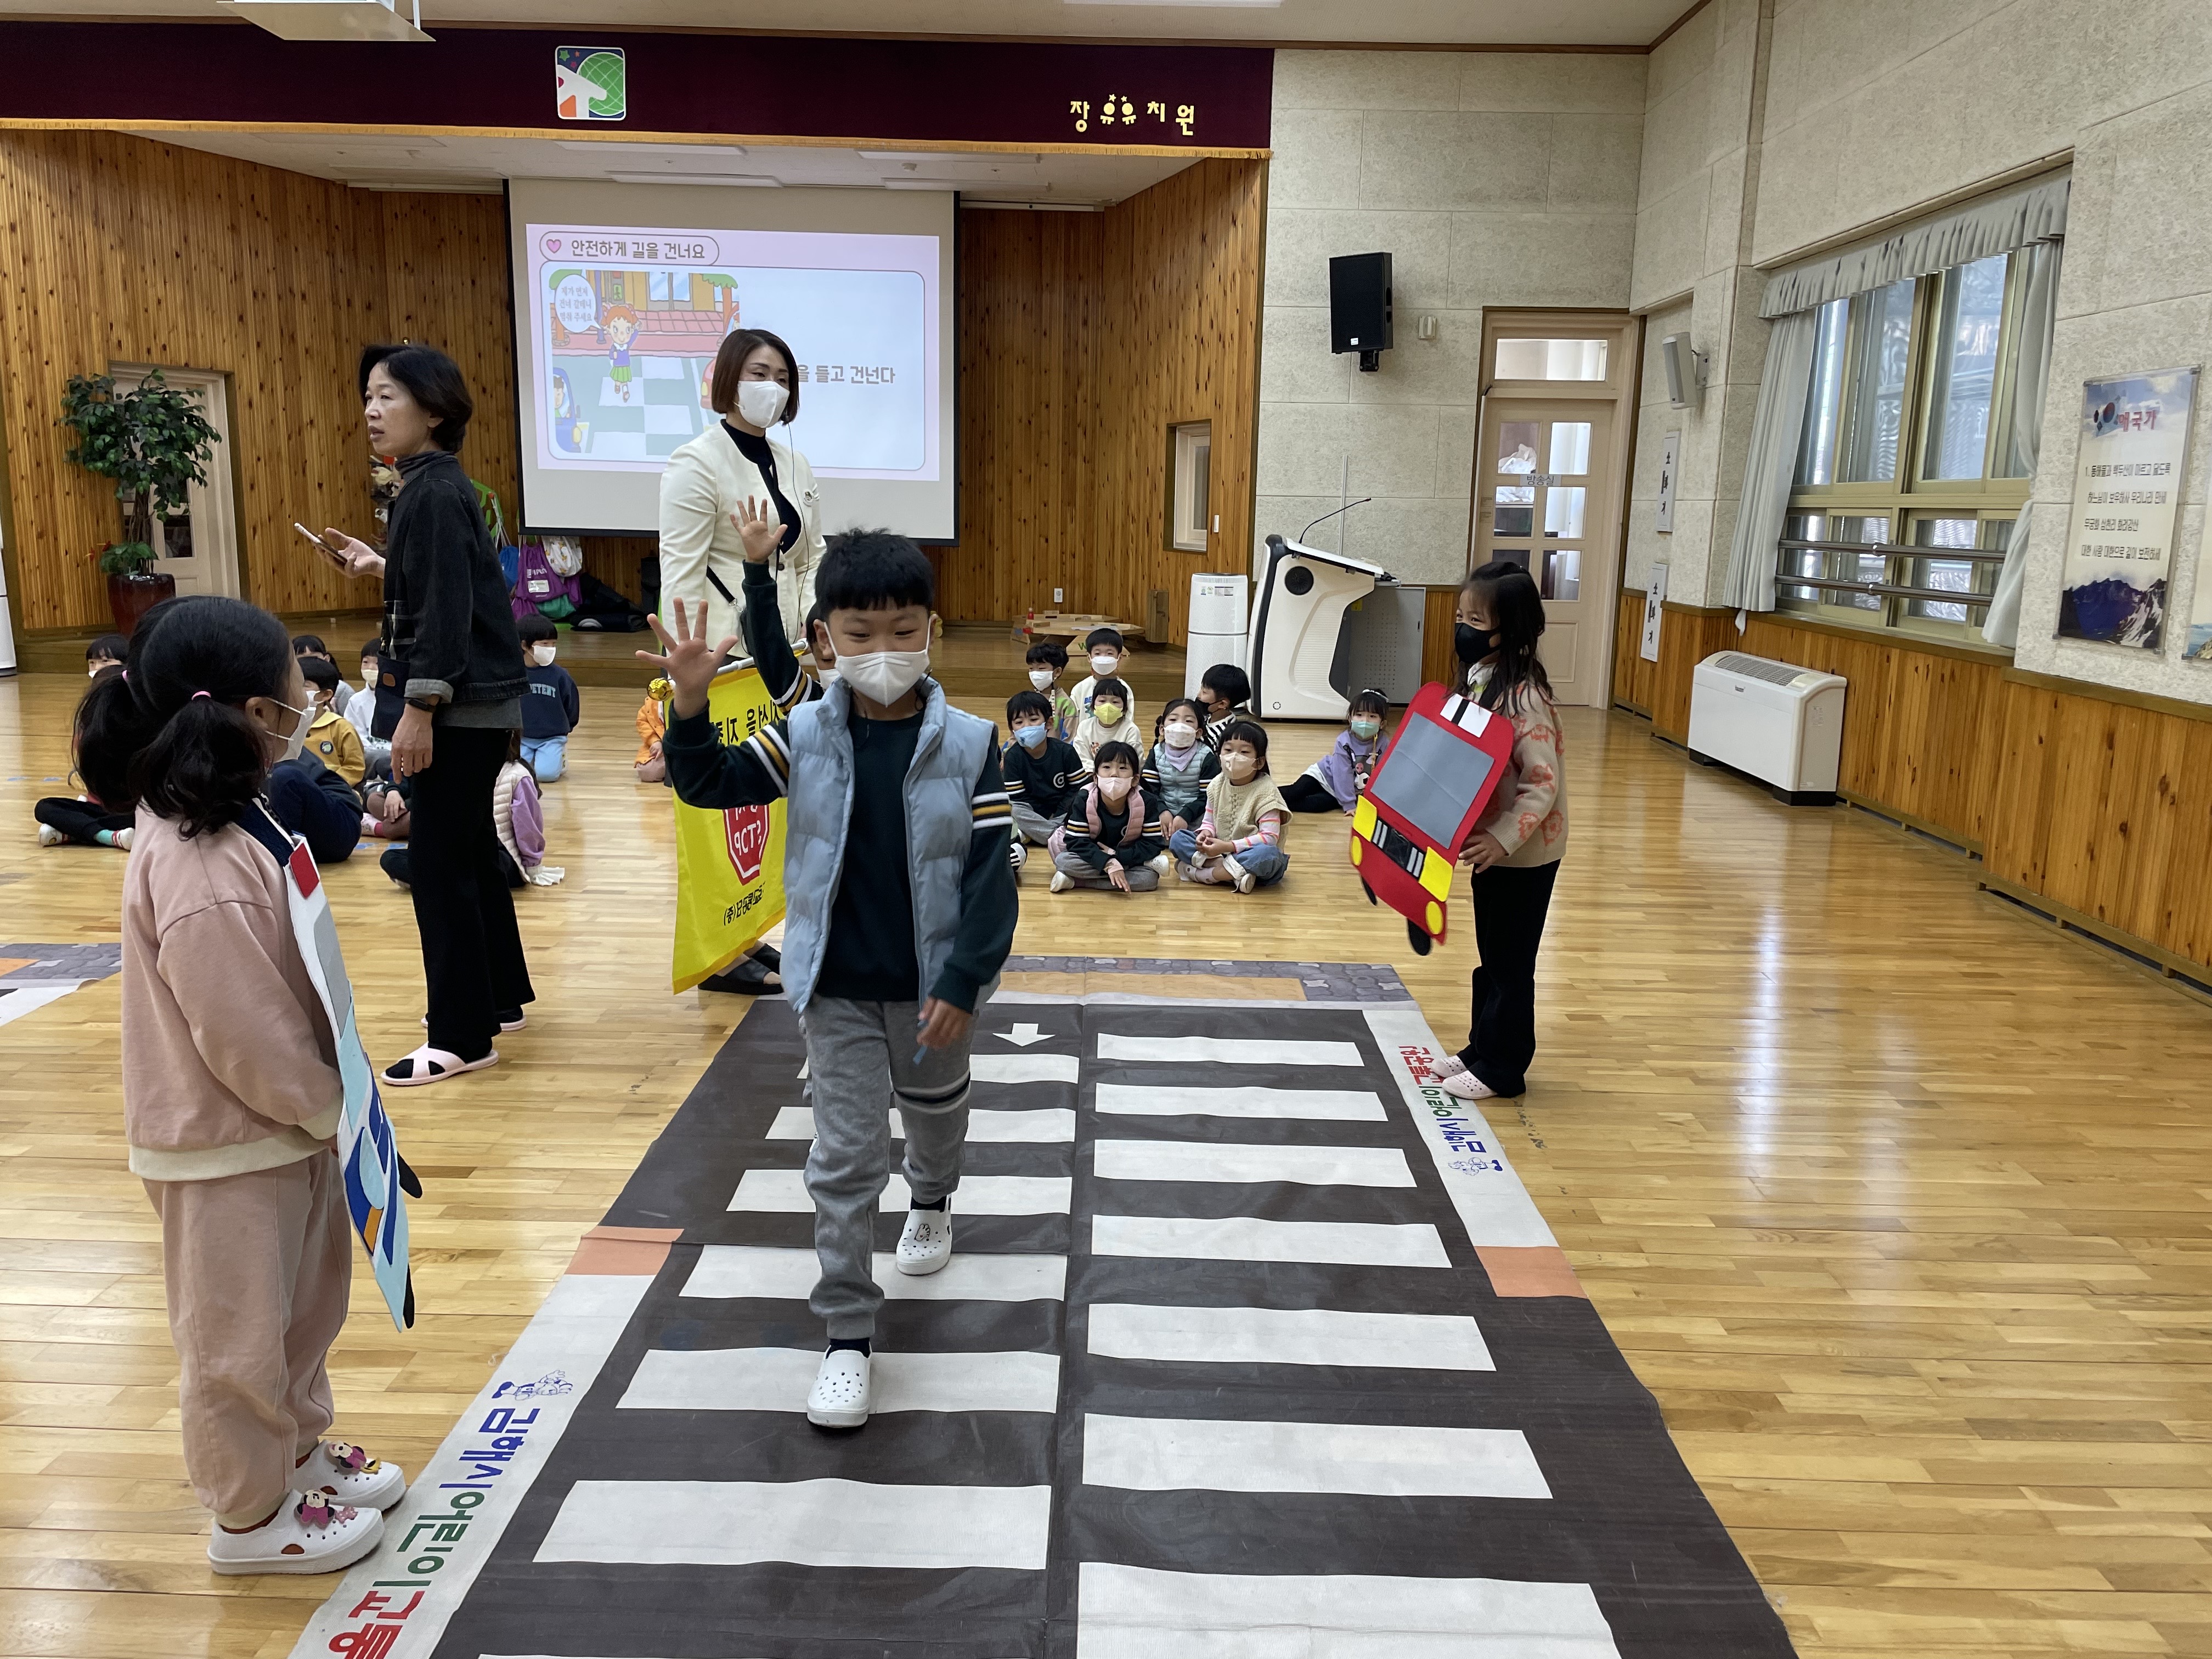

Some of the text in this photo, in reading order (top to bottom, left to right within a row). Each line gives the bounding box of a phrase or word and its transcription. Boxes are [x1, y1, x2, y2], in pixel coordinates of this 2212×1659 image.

[571, 240, 706, 259] 안전하게 길을 건너요
[797, 364, 896, 385] 을 들고 건넌다
[2118, 409, 2157, 432] 애국가
[1526, 475, 1555, 487] 방송실
